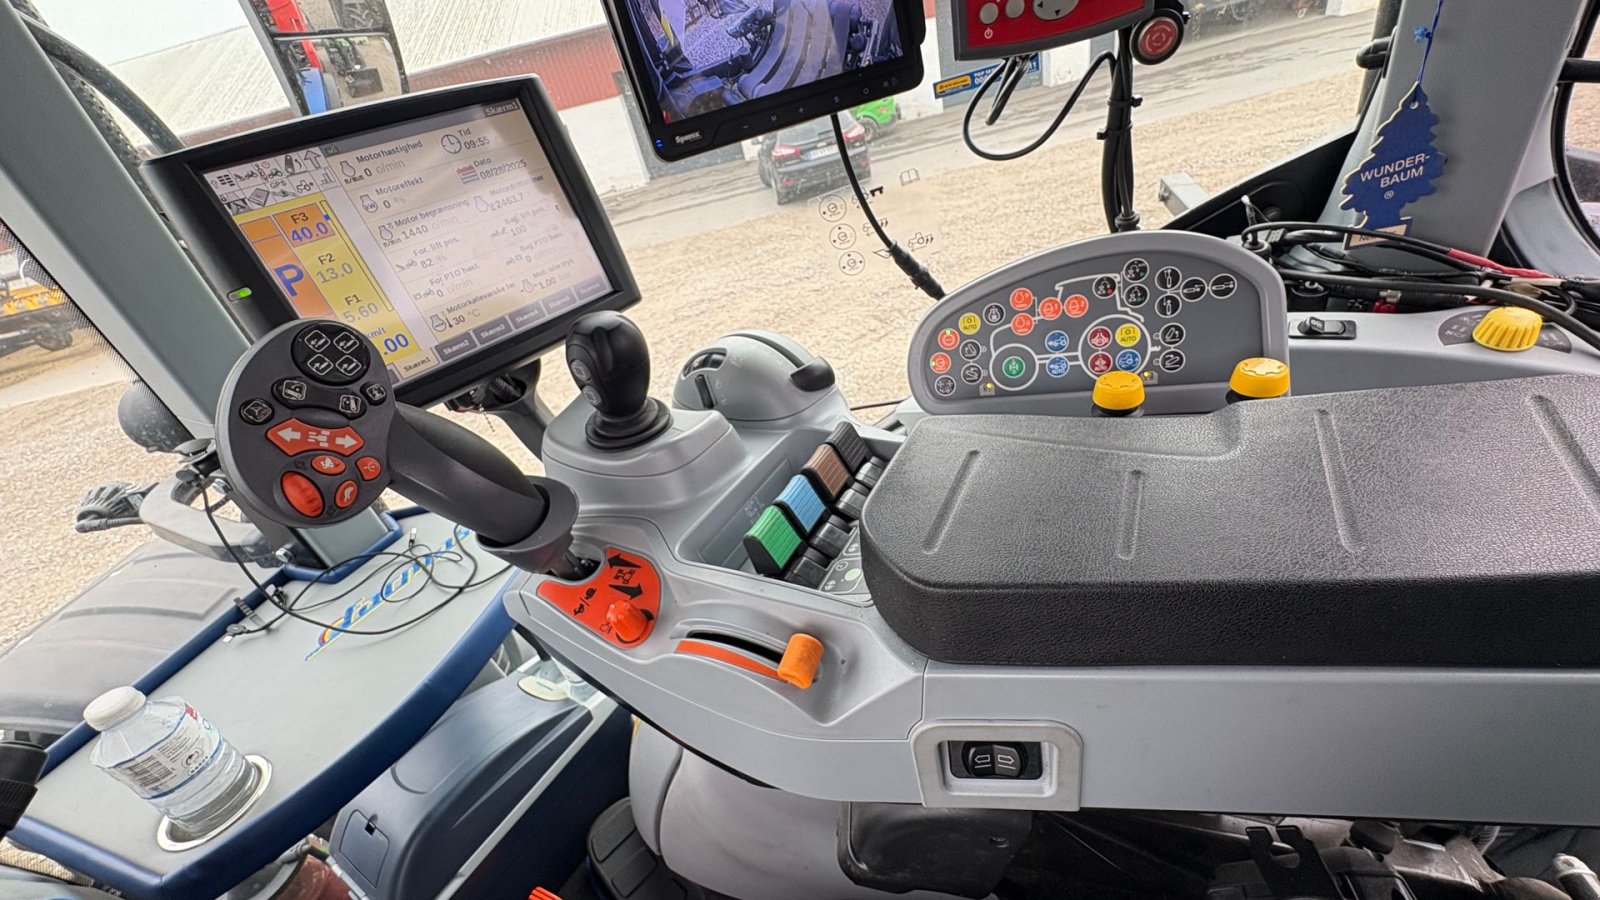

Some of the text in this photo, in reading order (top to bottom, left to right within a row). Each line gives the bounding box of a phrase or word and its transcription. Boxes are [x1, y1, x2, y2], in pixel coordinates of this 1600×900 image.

[458, 128, 470, 136] Tid
[463, 136, 489, 150] 09:55
[355, 140, 423, 164] Motorhastighed
[363, 168, 372, 177] 0
[479, 159, 526, 179] 08/28/2025
[1360, 153, 1431, 182] WUNDER-
[1380, 165, 1424, 188] BAUM
[269, 180, 286, 188] GPS
[375, 176, 423, 195] Motoreffekt
[382, 199, 391, 209] 0
[291, 212, 308, 223] F3
[394, 215, 418, 227] Motor
[290, 221, 329, 243] 40.0
[402, 224, 428, 239] 1440
[318, 253, 334, 265] F2
[274, 263, 304, 297] P
[316, 262, 353, 284] 13.0
[345, 293, 360, 305] F1
[343, 303, 378, 324] 5.60
[452, 314, 465, 325] 30
